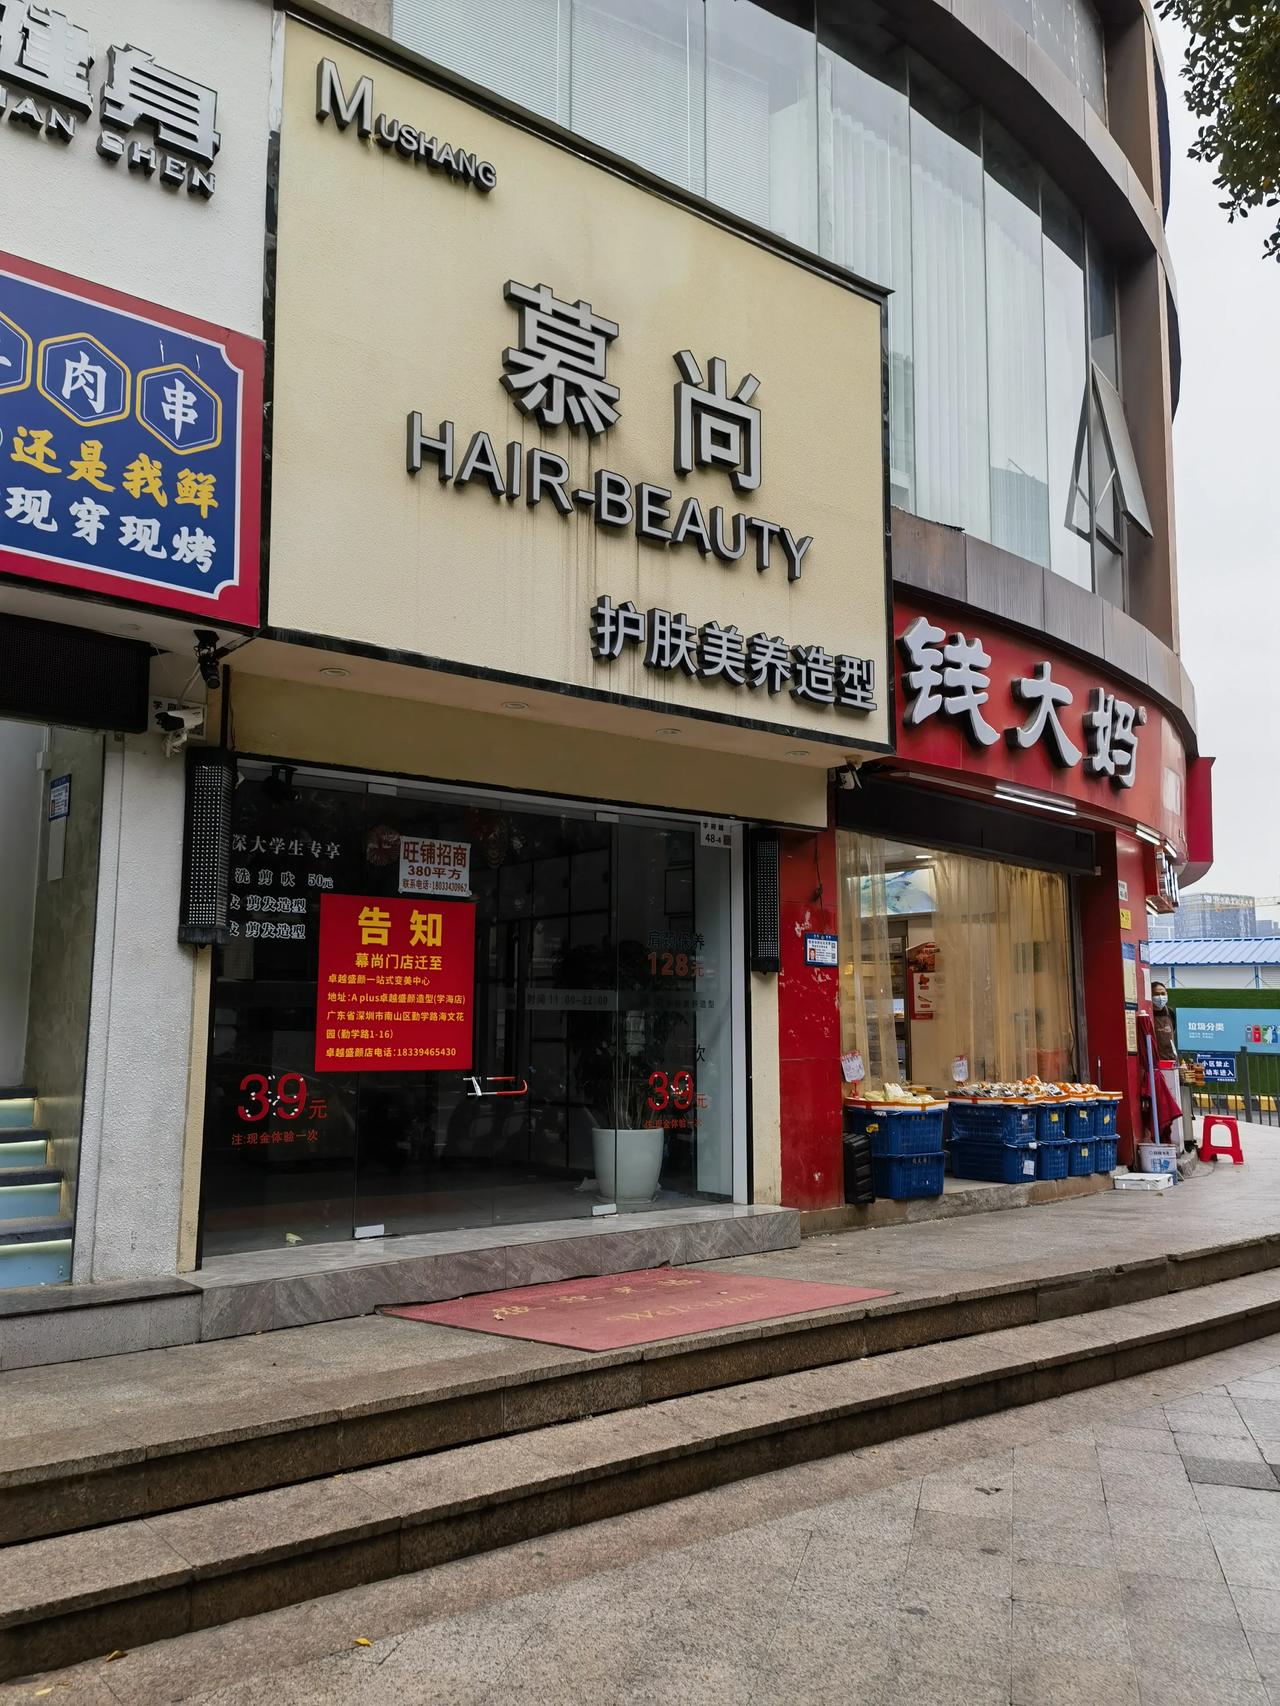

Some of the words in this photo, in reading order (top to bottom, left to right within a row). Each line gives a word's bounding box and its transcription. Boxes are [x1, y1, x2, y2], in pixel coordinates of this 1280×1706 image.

[97, 129, 217, 200] SHEN
[500, 280, 762, 491] 慕尚
[10, 426, 219, 519] 还是我鲜
[406, 411, 814, 581] HAIR-BEAUTY
[4, 486, 217, 573] 现穿现烤
[590, 594, 877, 713] 护肤美养造型
[897, 616, 1139, 789] 钱大妈
[402, 841, 467, 868] 旺铺招商
[407, 865, 463, 881] 380平方
[244, 921, 306, 940] 剪发造型
[245, 894, 307, 914] 剪发造型
[358, 906, 443, 947] 告知
[1203, 1069, 1234, 1077] 动车进入
